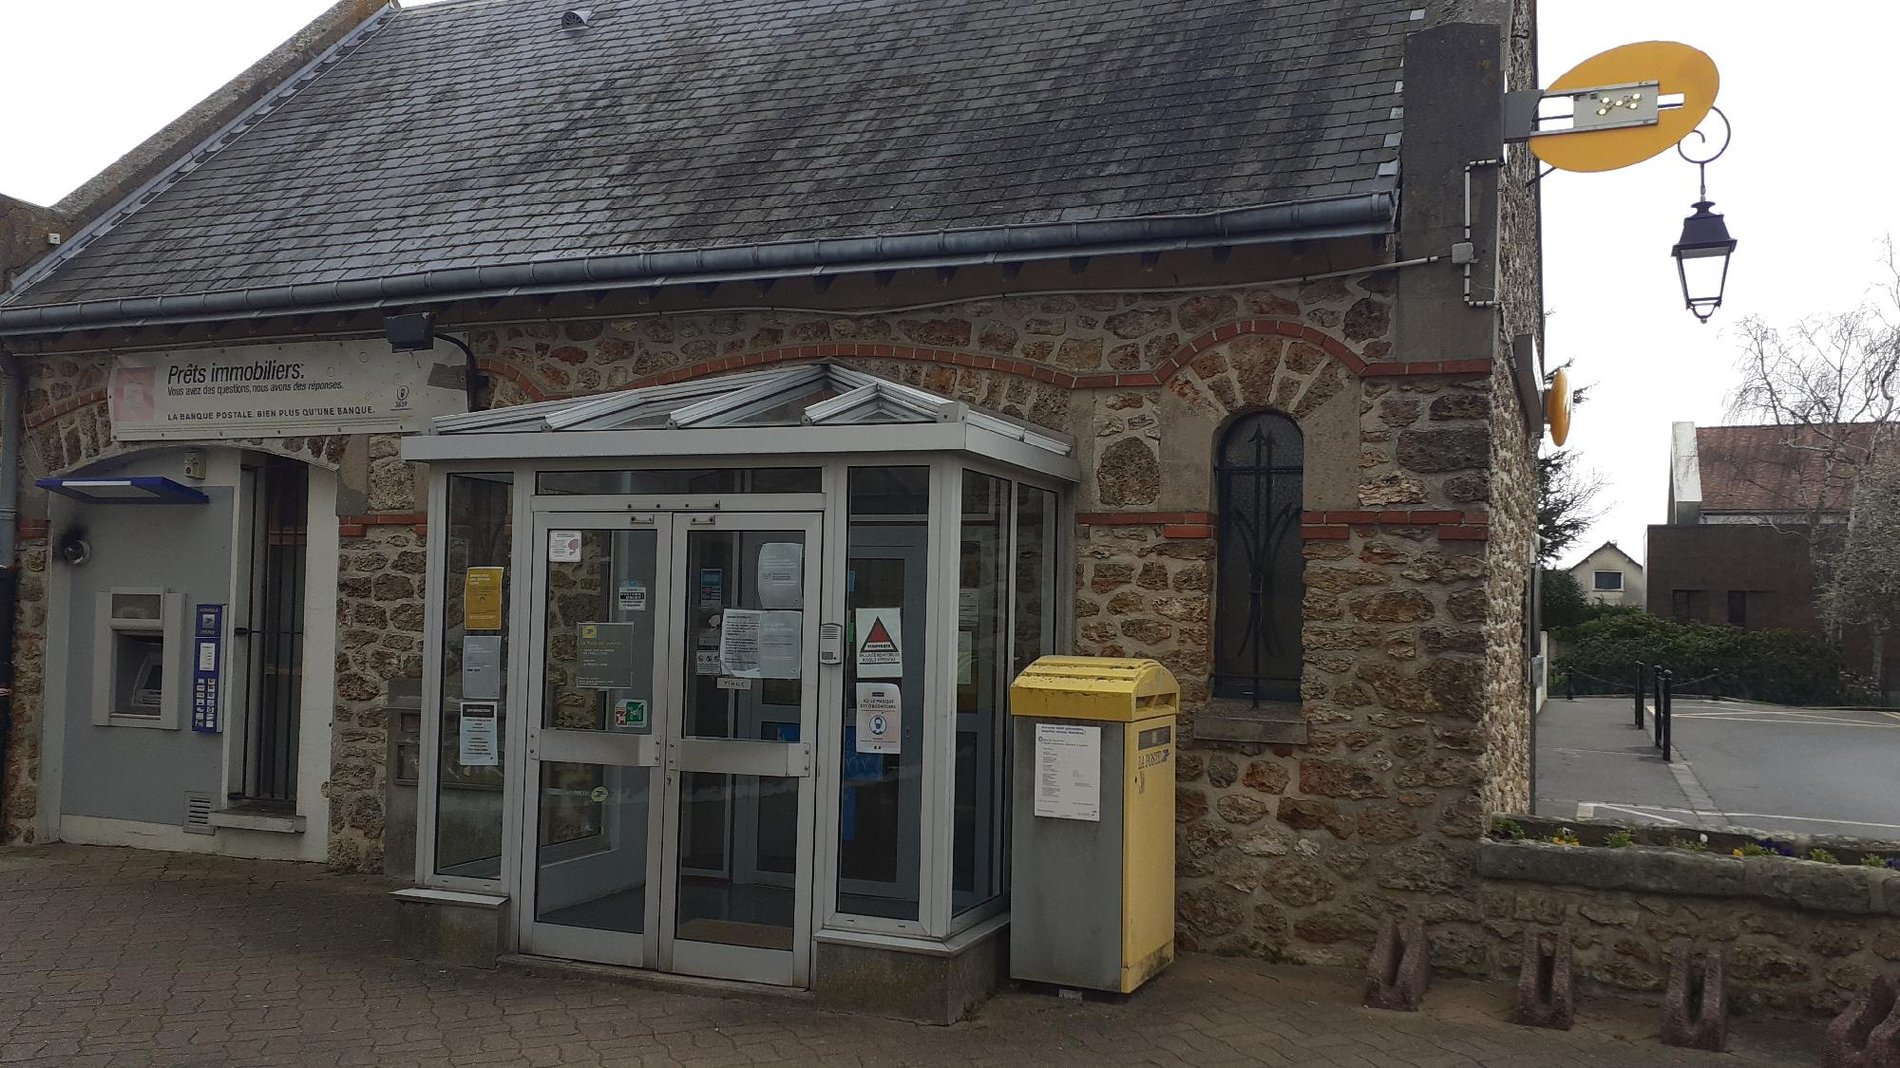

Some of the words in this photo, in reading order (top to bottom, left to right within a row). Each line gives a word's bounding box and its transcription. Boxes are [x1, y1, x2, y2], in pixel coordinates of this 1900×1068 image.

[168, 363, 207, 385] Prêts
[168, 386, 184, 396] Vous
[185, 387, 201, 396] avez
[202, 385, 216, 395] des
[216, 384, 252, 396] questions,
[252, 384, 269, 392] nous
[270, 383, 292, 393] avons
[293, 382, 307, 391] des
[308, 380, 344, 392] réponses.
[168, 413, 178, 421] LA
[179, 411, 214, 421] BANQUE
[216, 410, 255, 420] POSTALE.
[256, 409, 276, 418] BIEN
[279, 408, 300, 417] PLUS
[302, 407, 335, 417] QU'UNE
[337, 405, 376, 415] BANQUE.
